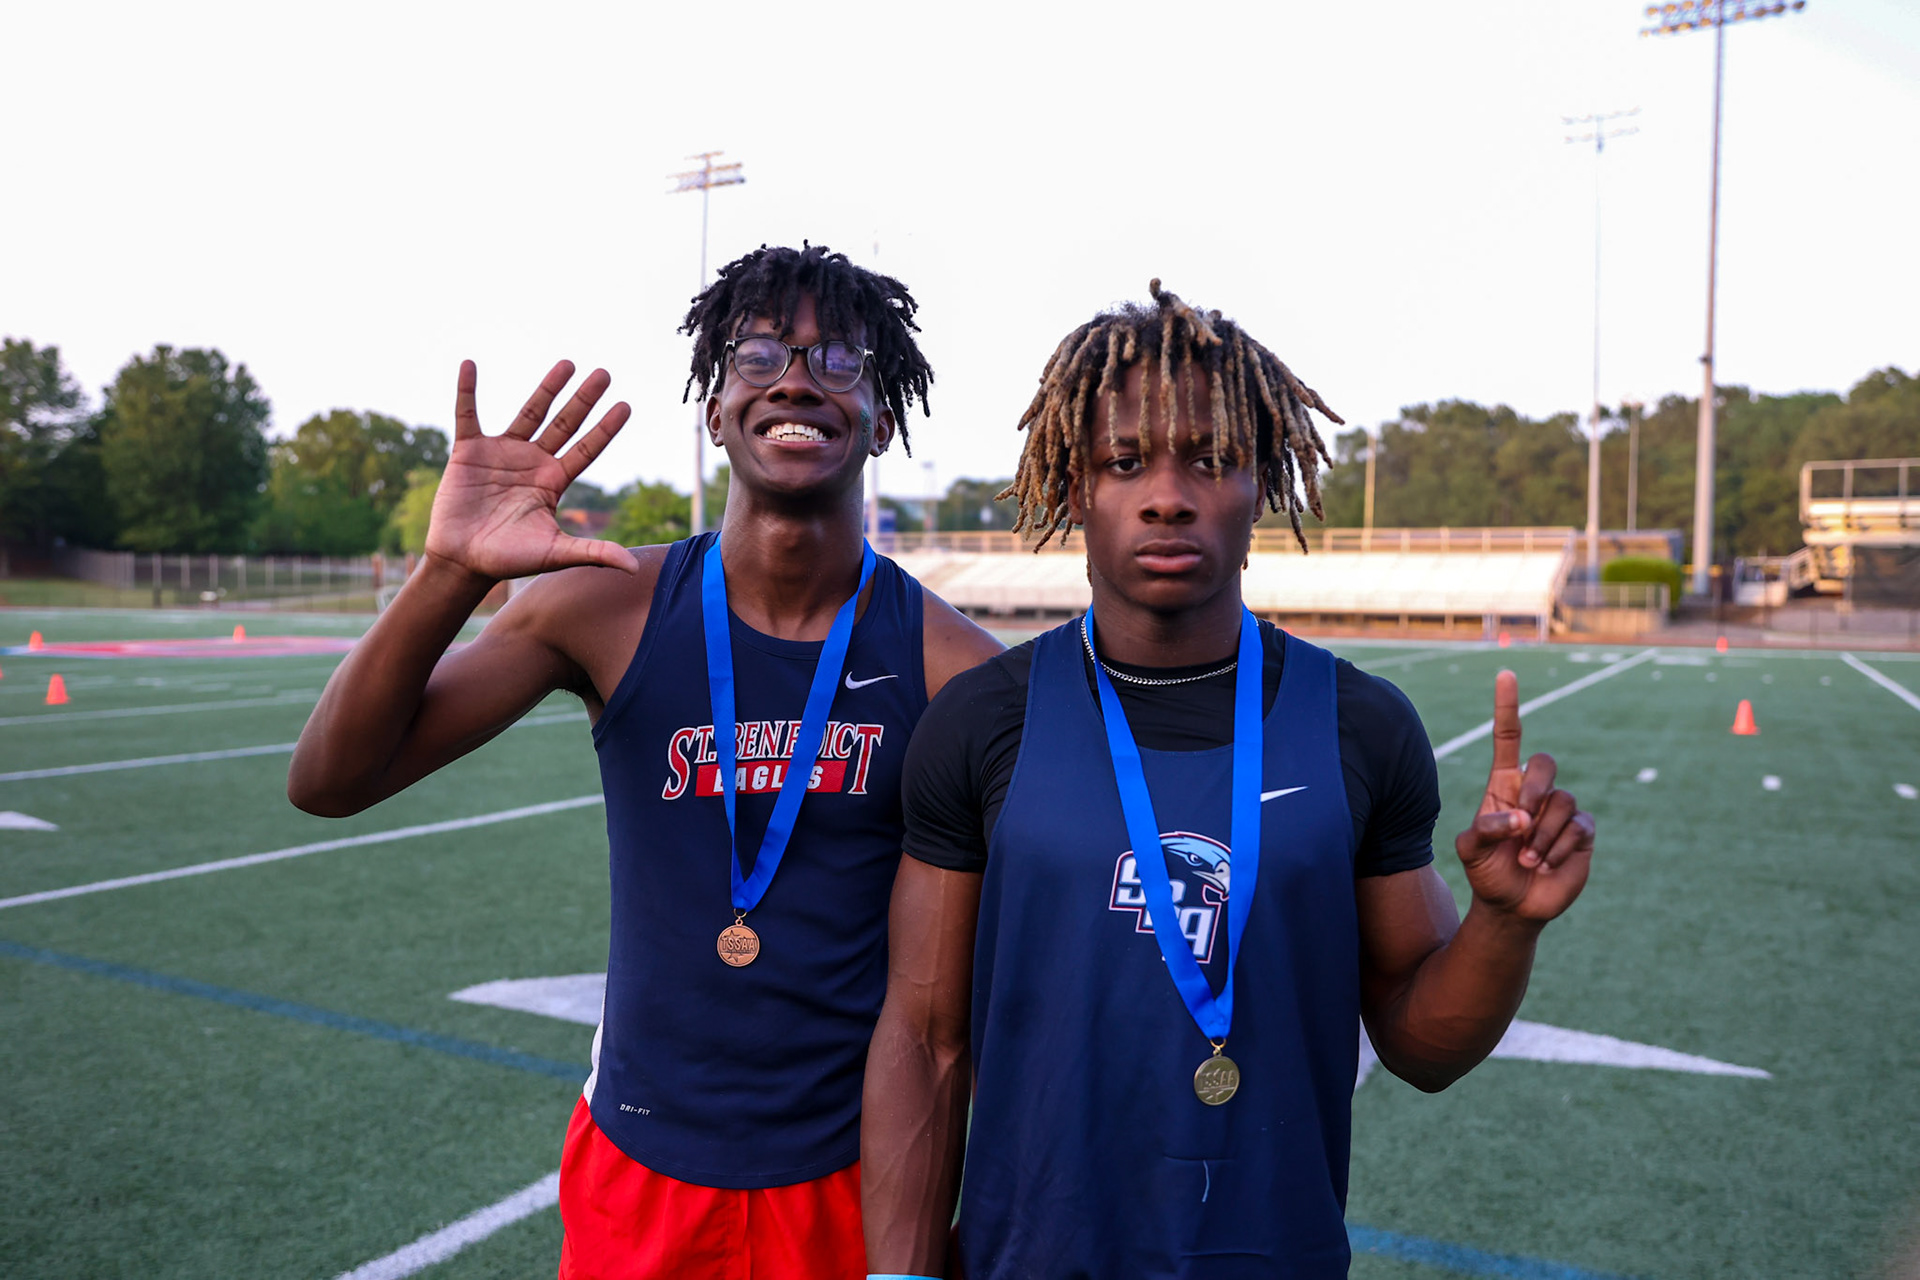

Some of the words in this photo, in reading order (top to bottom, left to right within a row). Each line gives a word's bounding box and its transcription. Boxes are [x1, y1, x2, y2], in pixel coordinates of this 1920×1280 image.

[661, 725, 718, 800] ST.
[733, 721, 885, 796] BENEICT
[713, 765, 824, 793] EAGLS
[721, 937, 755, 950] TSSAA
[619, 1103, 651, 1116] DRI-FIT
